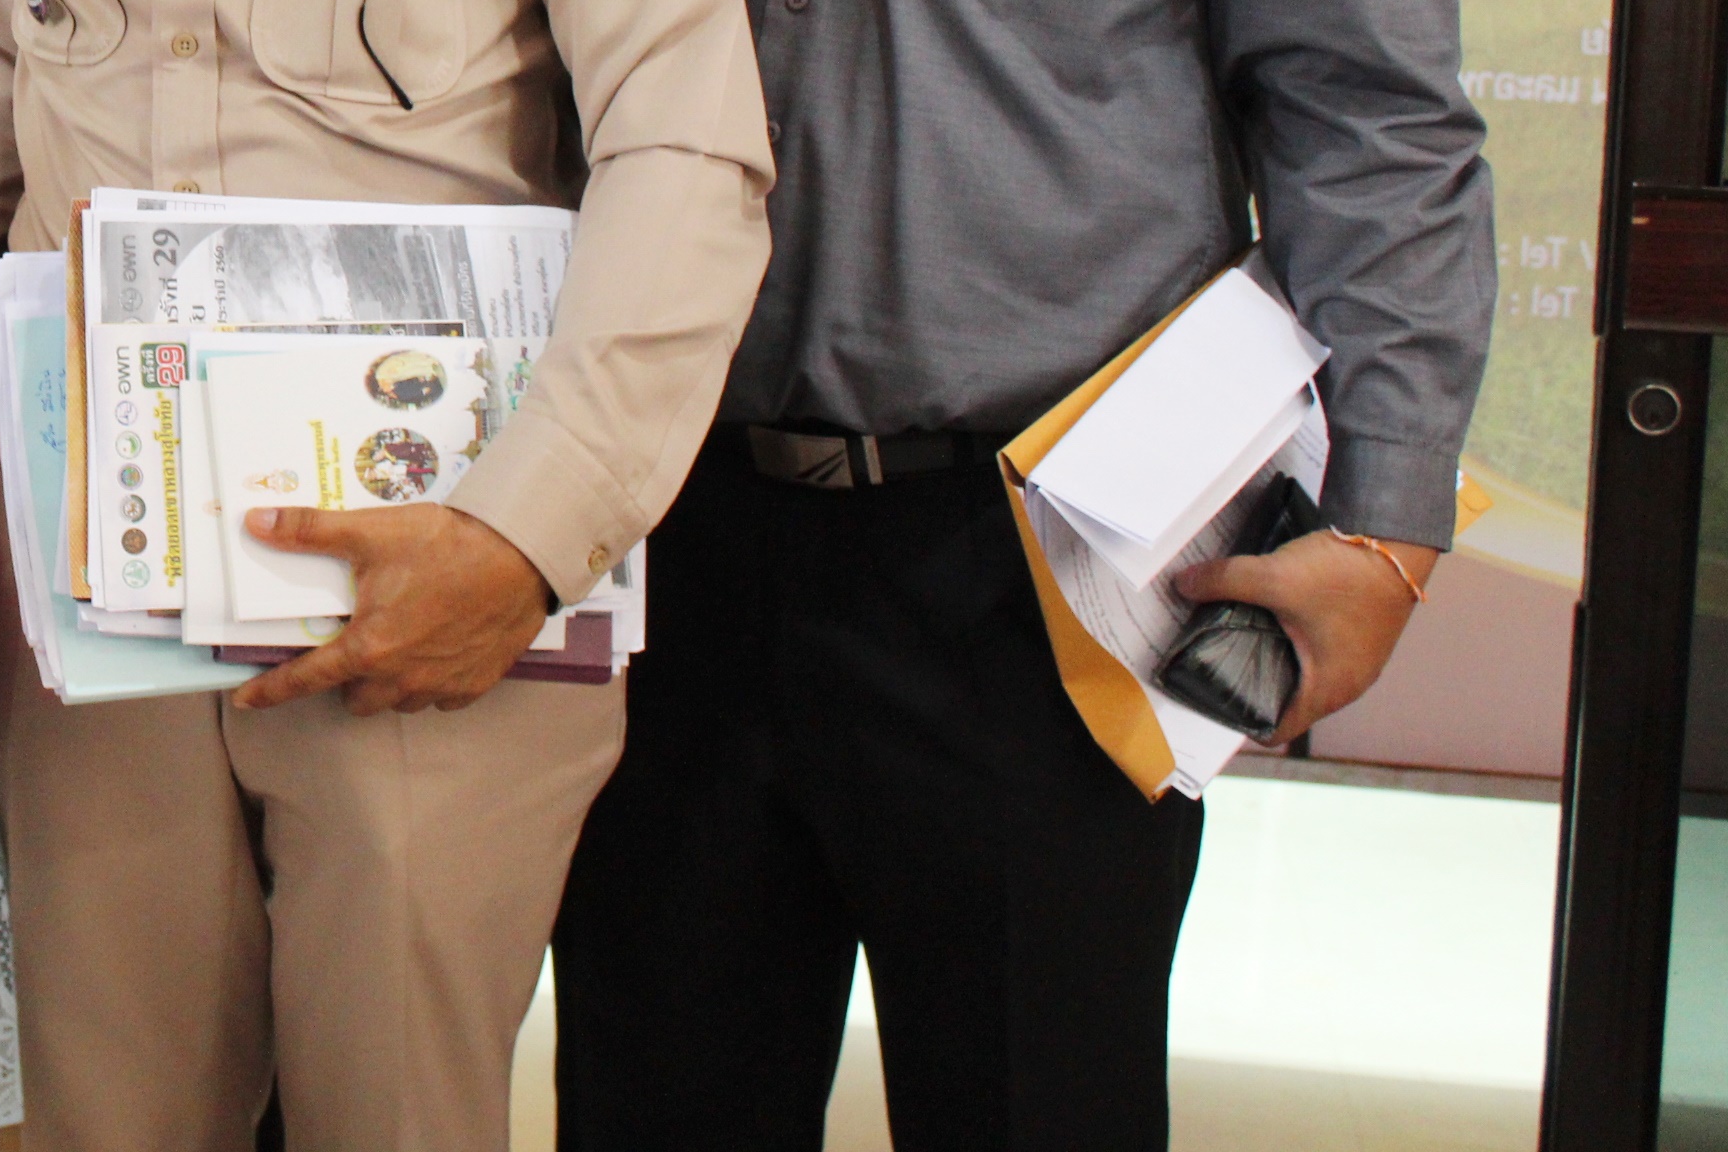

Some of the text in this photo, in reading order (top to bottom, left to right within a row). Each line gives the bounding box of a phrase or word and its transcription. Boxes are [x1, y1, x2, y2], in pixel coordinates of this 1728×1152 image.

[120, 234, 137, 282] อพท
[151, 227, 181, 267] 29
[213, 244, 226, 274] 2560
[115, 345, 133, 394] อพท
[139, 348, 157, 385] ครั้งที่
[156, 344, 186, 386] 29
